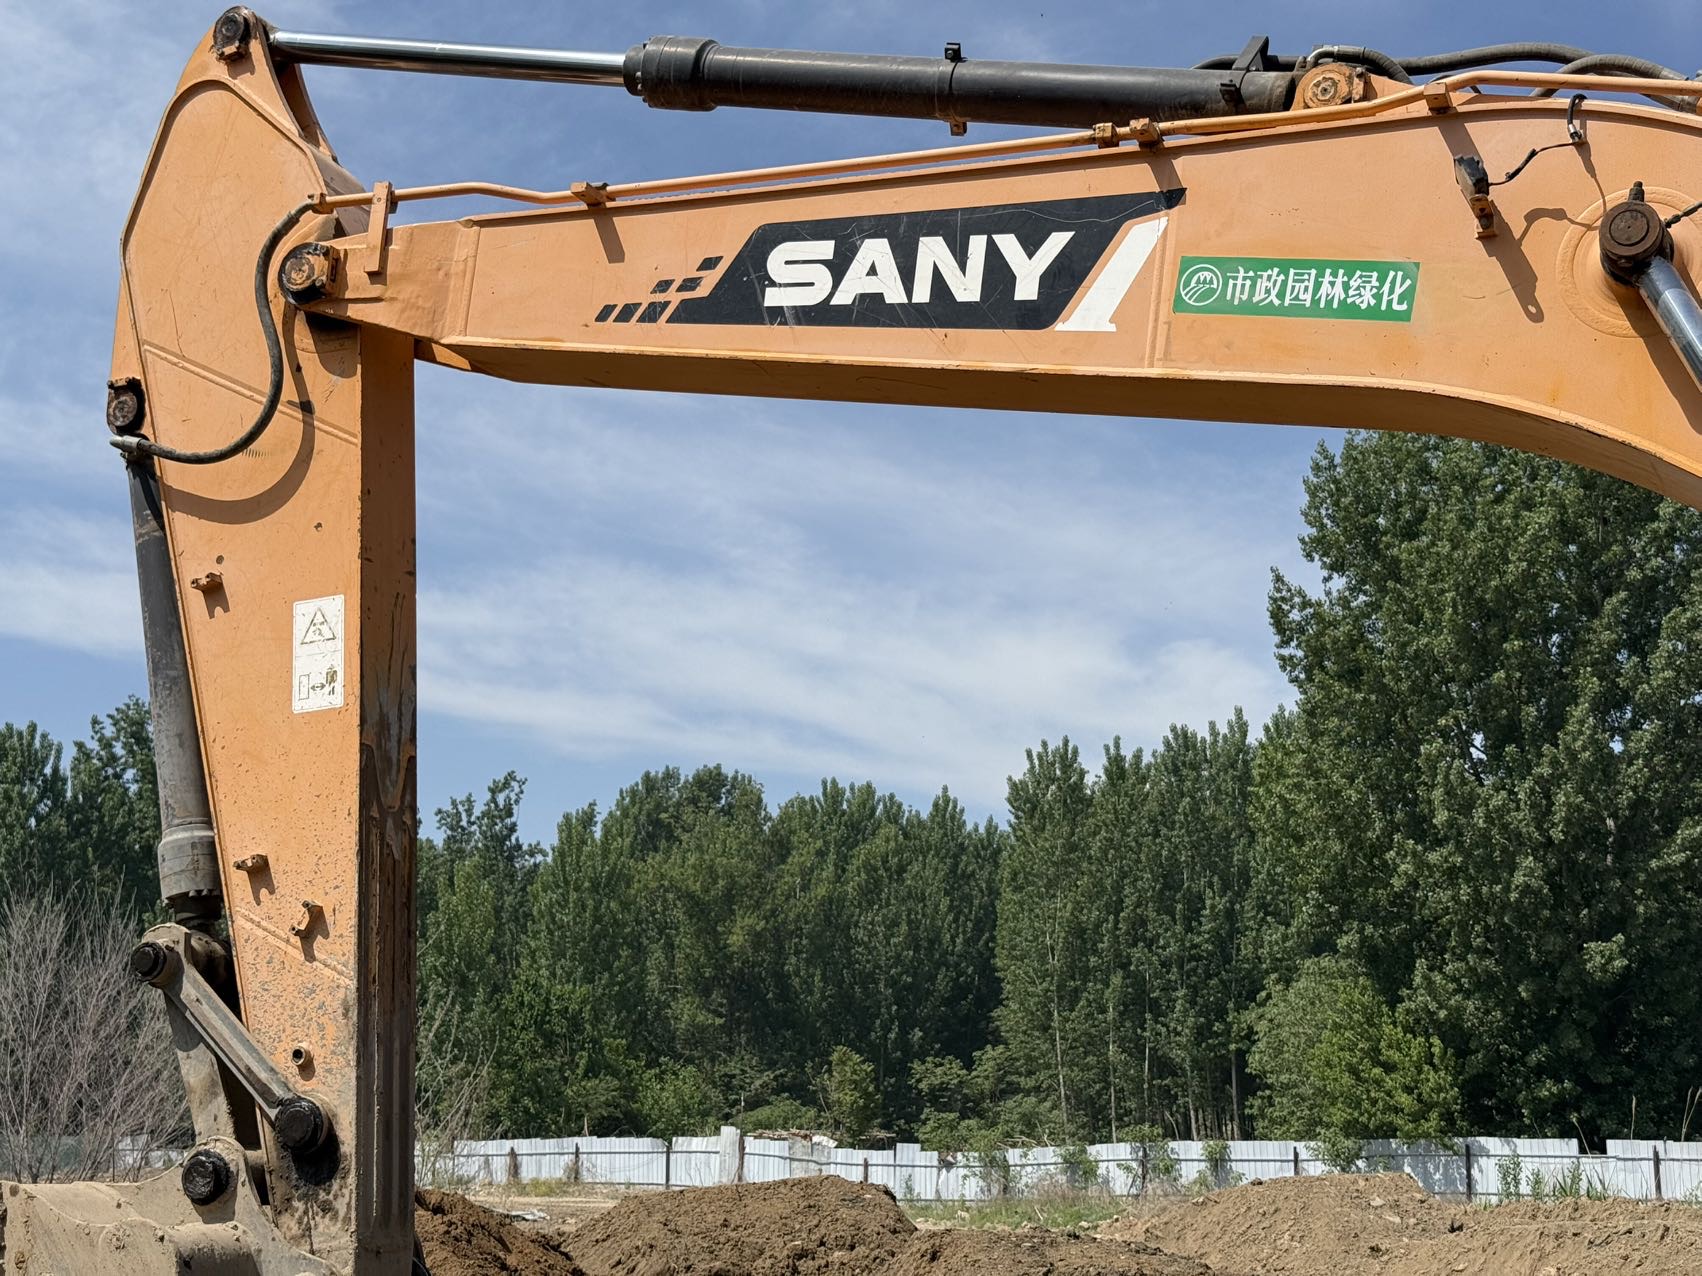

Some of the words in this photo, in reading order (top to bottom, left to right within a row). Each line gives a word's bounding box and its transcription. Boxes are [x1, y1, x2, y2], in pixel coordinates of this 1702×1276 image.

[764, 231, 1075, 307] SANY
[1226, 266, 1412, 311] 市政园林绿化
